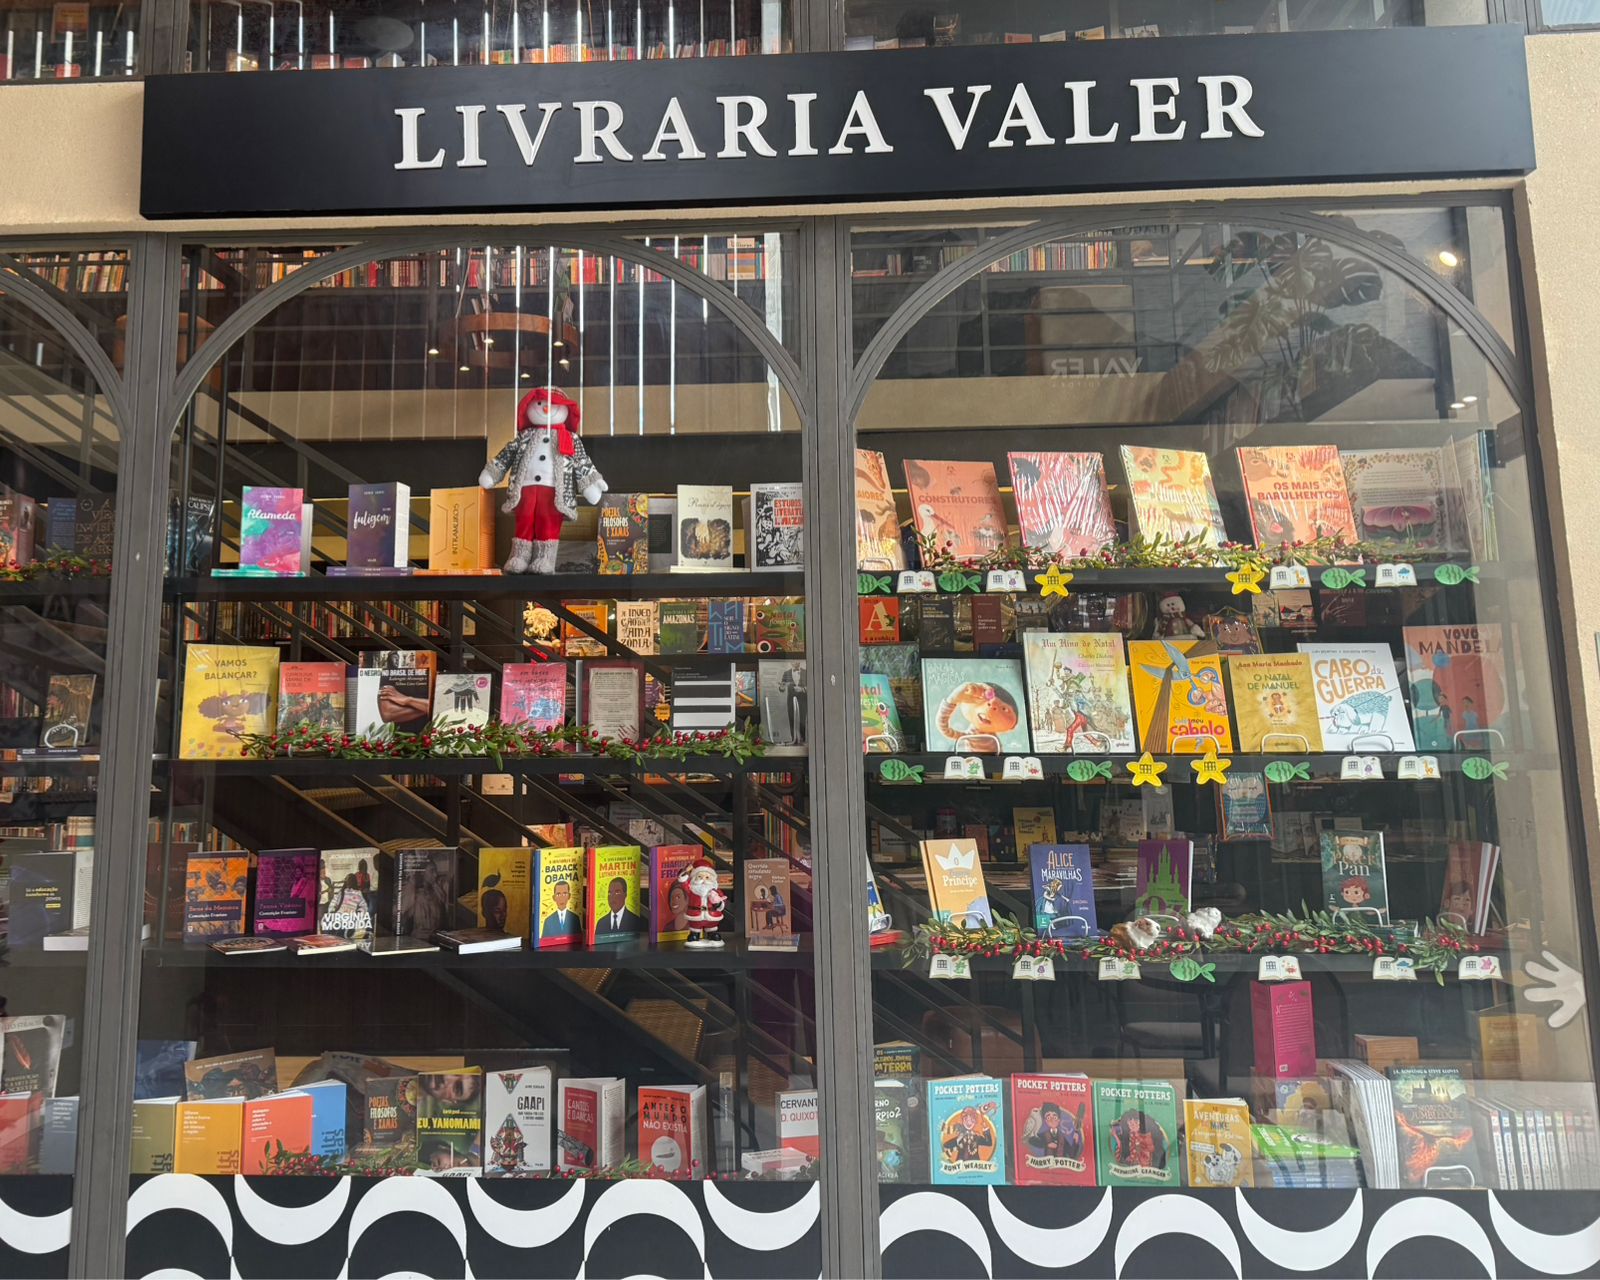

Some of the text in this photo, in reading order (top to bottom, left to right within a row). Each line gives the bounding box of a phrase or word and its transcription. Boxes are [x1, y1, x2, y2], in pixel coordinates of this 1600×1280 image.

[394, 75, 1266, 170] LIVRARIA VALER
[1273, 480, 1320, 491] OS MAIS
[857, 488, 885, 502] AIORES
[1256, 490, 1342, 502] BARULHENTOS
[246, 508, 297, 521] Alameda
[353, 510, 391, 530] fuligem
[451, 503, 460, 555] INTRAMUROS
[662, 613, 696, 625] AMAZONAS
[214, 659, 248, 668] VAMOS
[1252, 660, 1271, 669] Maria
[1314, 658, 1371, 680] CABO
[204, 670, 258, 682] BALANÇAR?
[382, 669, 389, 677] NO
[390, 669, 407, 677] BRASIL
[1253, 673, 1293, 682] O NATAL
[1247, 681, 1301, 691] DE MANUEL
[1316, 674, 1386, 705] GUERRA
[599, 860, 637, 872] MARTIN
[1047, 850, 1075, 870] ALICE
[545, 863, 578, 874] BARACK
[1338, 860, 1371, 876] Pan
[544, 872, 580, 885] OBAMA
[1040, 867, 1083, 883] MARAVILHAS
[321, 919, 373, 931] MORDIDA
[883, 1061, 912, 1073] TERRA
[934, 1082, 1000, 1095] POCKET POTTERS
[1016, 1078, 1088, 1093] POCKET POTTERS
[1100, 1087, 1172, 1101] POCKET POTTERS
[517, 1096, 545, 1111] GAAPI
[643, 1102, 687, 1114] ANTES O
[417, 1117, 481, 1130] EU, YANOMAMI
[643, 1111, 688, 1124] MUNDO
[1193, 1111, 1240, 1123] AVENTURAS
[642, 1120, 689, 1135] NÃO EXISTIA
[1210, 1120, 1230, 1132] MIKE
[943, 1161, 993, 1172] RONY WEASLEY
[1029, 1156, 1082, 1170] HARRY POTTER
